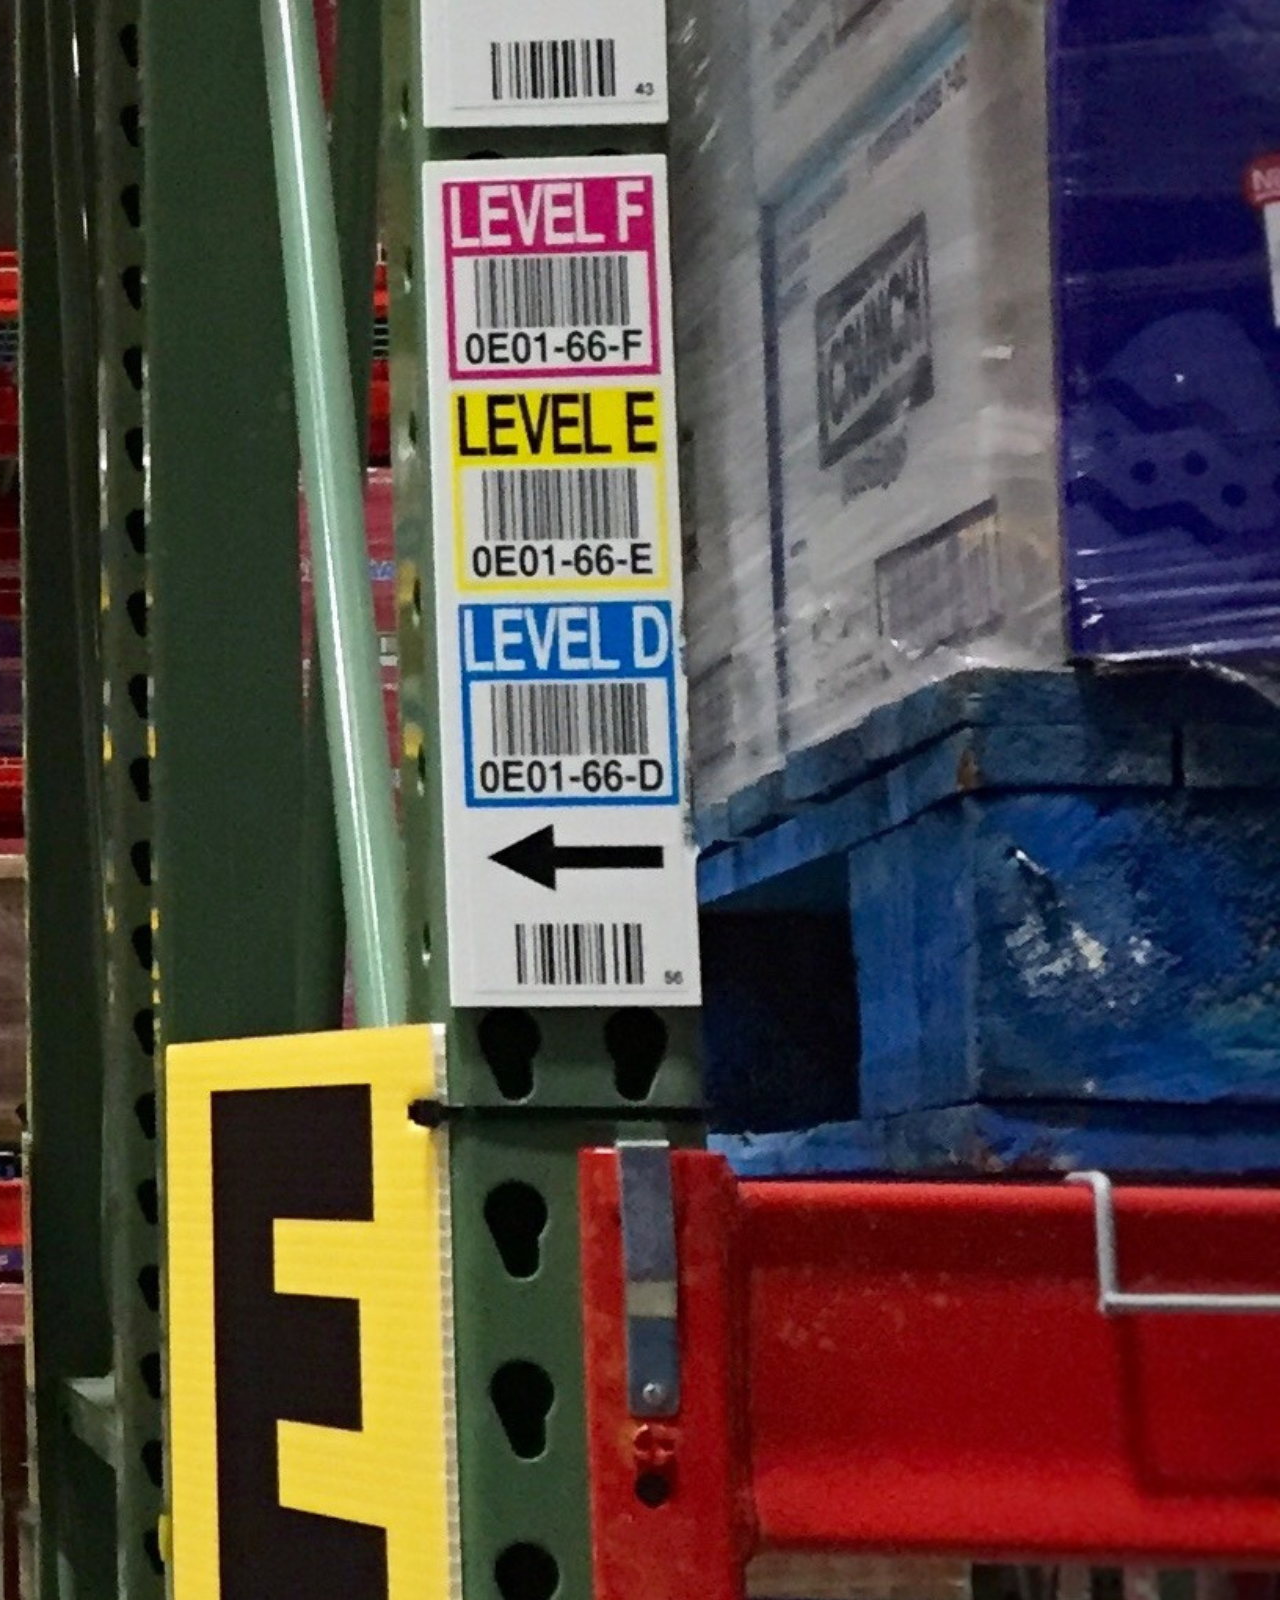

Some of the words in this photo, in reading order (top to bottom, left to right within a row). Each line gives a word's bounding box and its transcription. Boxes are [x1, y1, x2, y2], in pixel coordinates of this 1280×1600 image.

[635, 82, 654, 96] 43
[450, 181, 605, 248] LEVEL
[616, 180, 645, 243] F
[465, 330, 643, 364] 0E01-66-F
[829, 252, 920, 426] CRUNCH
[457, 393, 612, 456] LEVEL
[626, 391, 657, 453] E
[472, 543, 653, 577] 0E01-66-E
[464, 606, 620, 672] LEVEL
[632, 605, 669, 669] D
[480, 759, 663, 793] 0E01-66-D
[210, 1083, 389, 1600] E
